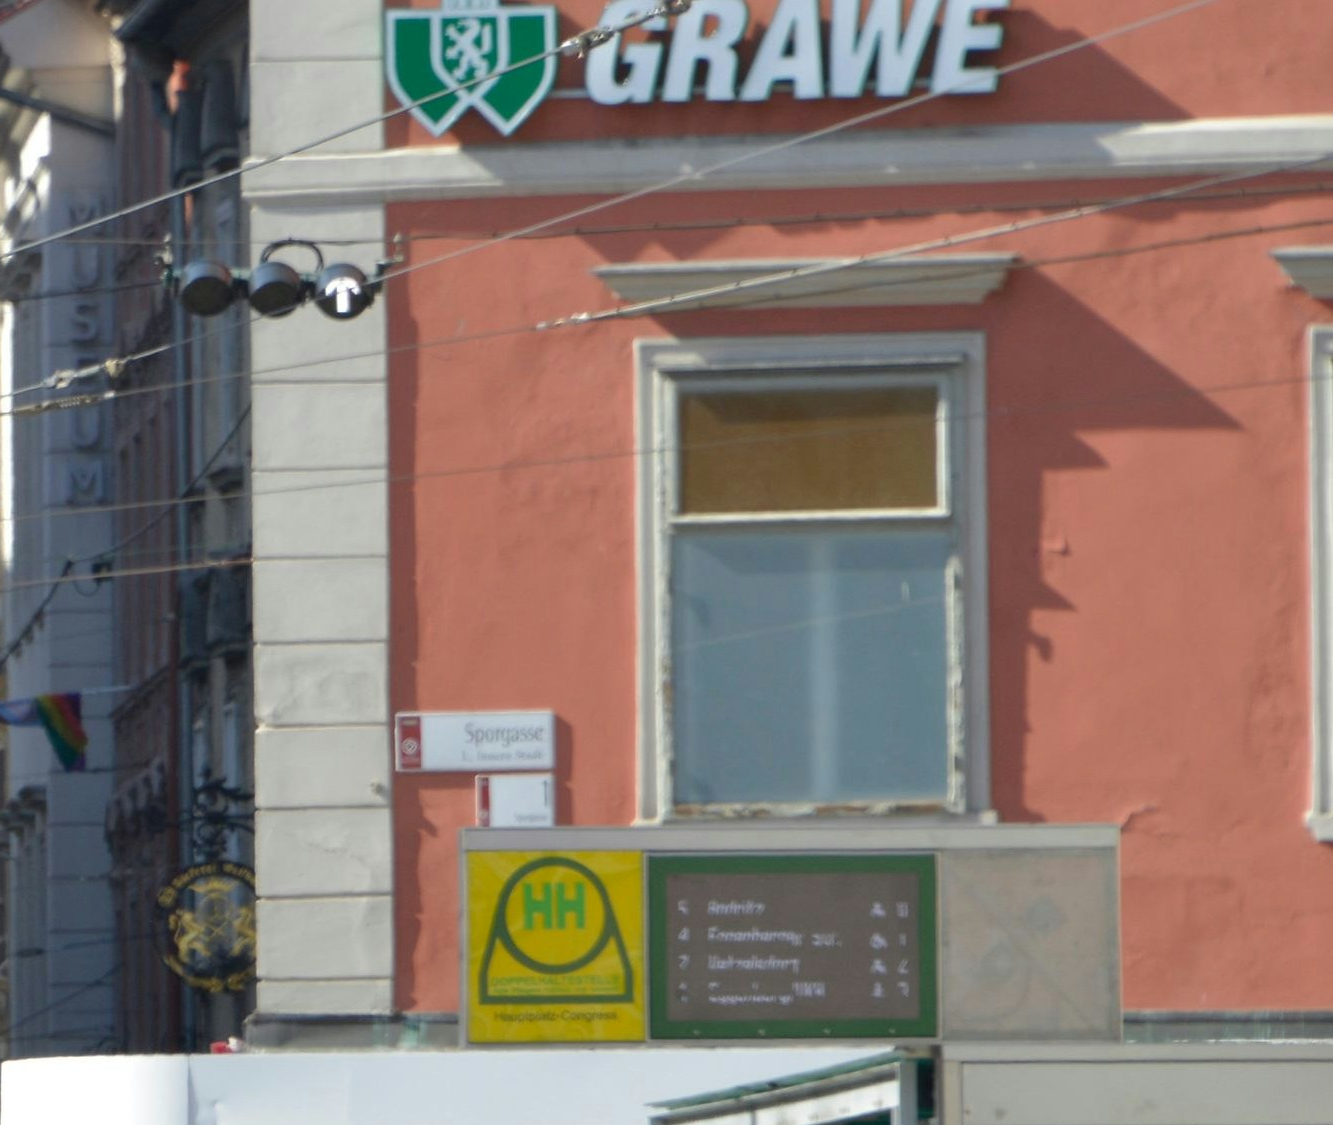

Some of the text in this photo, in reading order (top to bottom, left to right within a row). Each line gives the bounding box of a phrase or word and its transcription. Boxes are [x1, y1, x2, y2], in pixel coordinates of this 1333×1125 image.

[585, 0, 1009, 106] GRAWE
[463, 721, 545, 748] Sporgasse
[523, 882, 586, 930] HH
